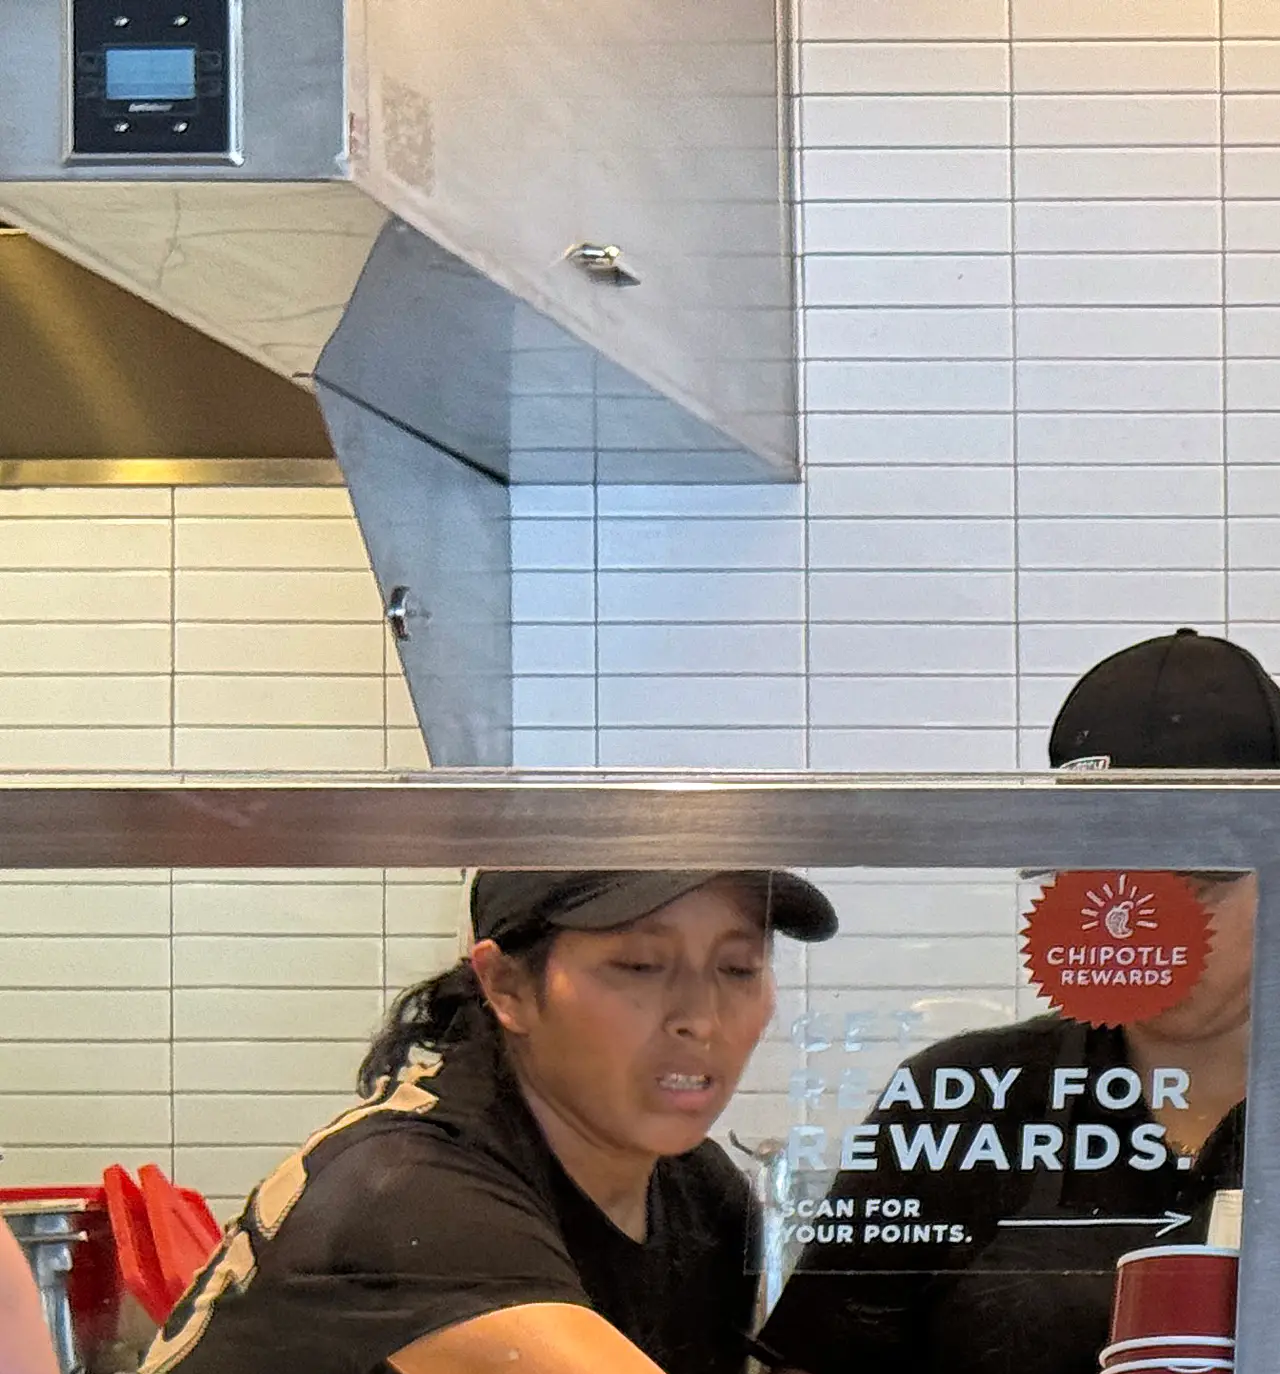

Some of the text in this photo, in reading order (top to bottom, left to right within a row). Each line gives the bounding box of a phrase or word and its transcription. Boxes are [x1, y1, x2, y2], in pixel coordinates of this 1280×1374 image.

[1046, 946, 1188, 966] CHIPOTLE
[1060, 968, 1173, 987] REWARDS
[787, 1066, 1191, 1110] READY FOR
[788, 1123, 1192, 1172] REWARDS.
[780, 1199, 921, 1218] SCAN FOR
[781, 1224, 973, 1244] YOUR POINTS.
